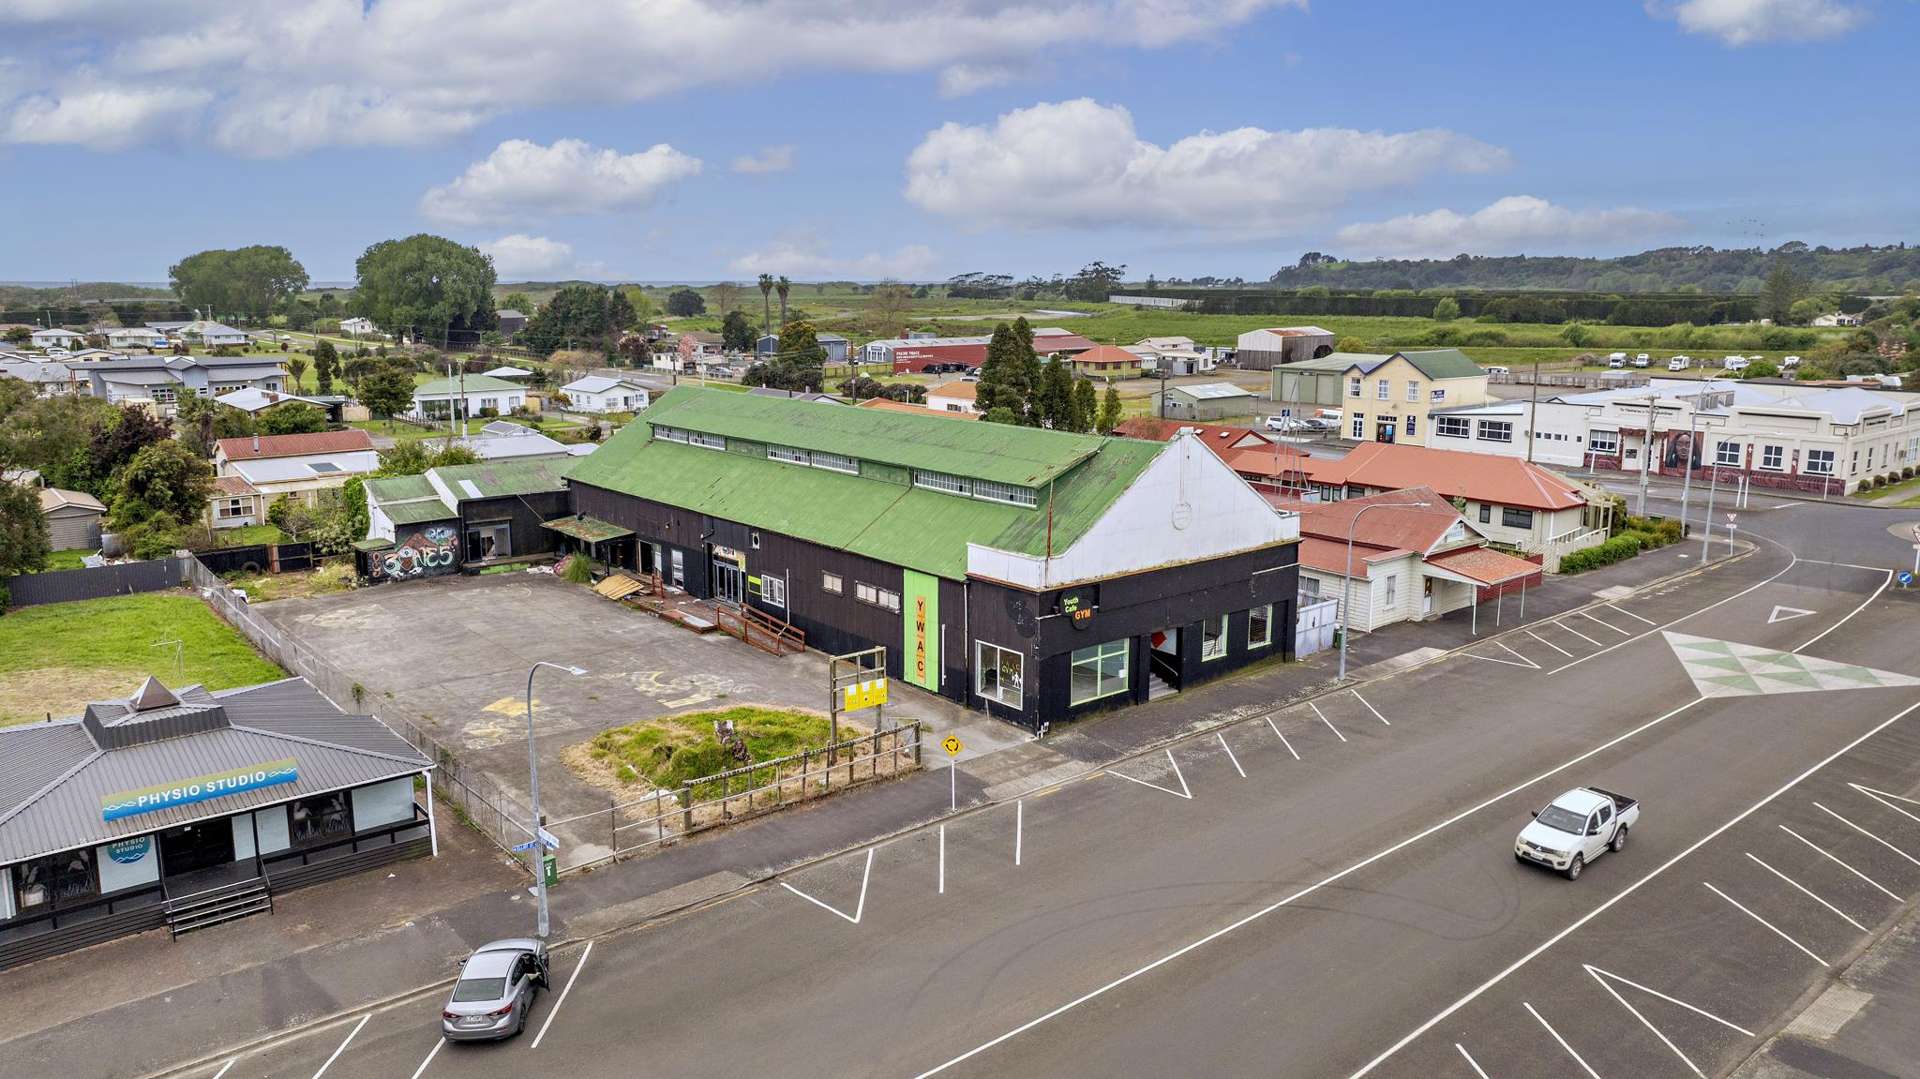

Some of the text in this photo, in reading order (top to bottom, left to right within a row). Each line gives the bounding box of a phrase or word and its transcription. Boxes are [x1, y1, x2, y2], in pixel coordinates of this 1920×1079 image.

[1063, 596, 1079, 606] Youth
[1065, 605, 1078, 613] Cafe
[1074, 608, 1091, 620] GYM
[916, 600, 925, 672] YWAC
[138, 771, 266, 807] PHYSIO STUDIO
[112, 836, 145, 849] PHYSIO
[116, 844, 143, 854] STUDIO
